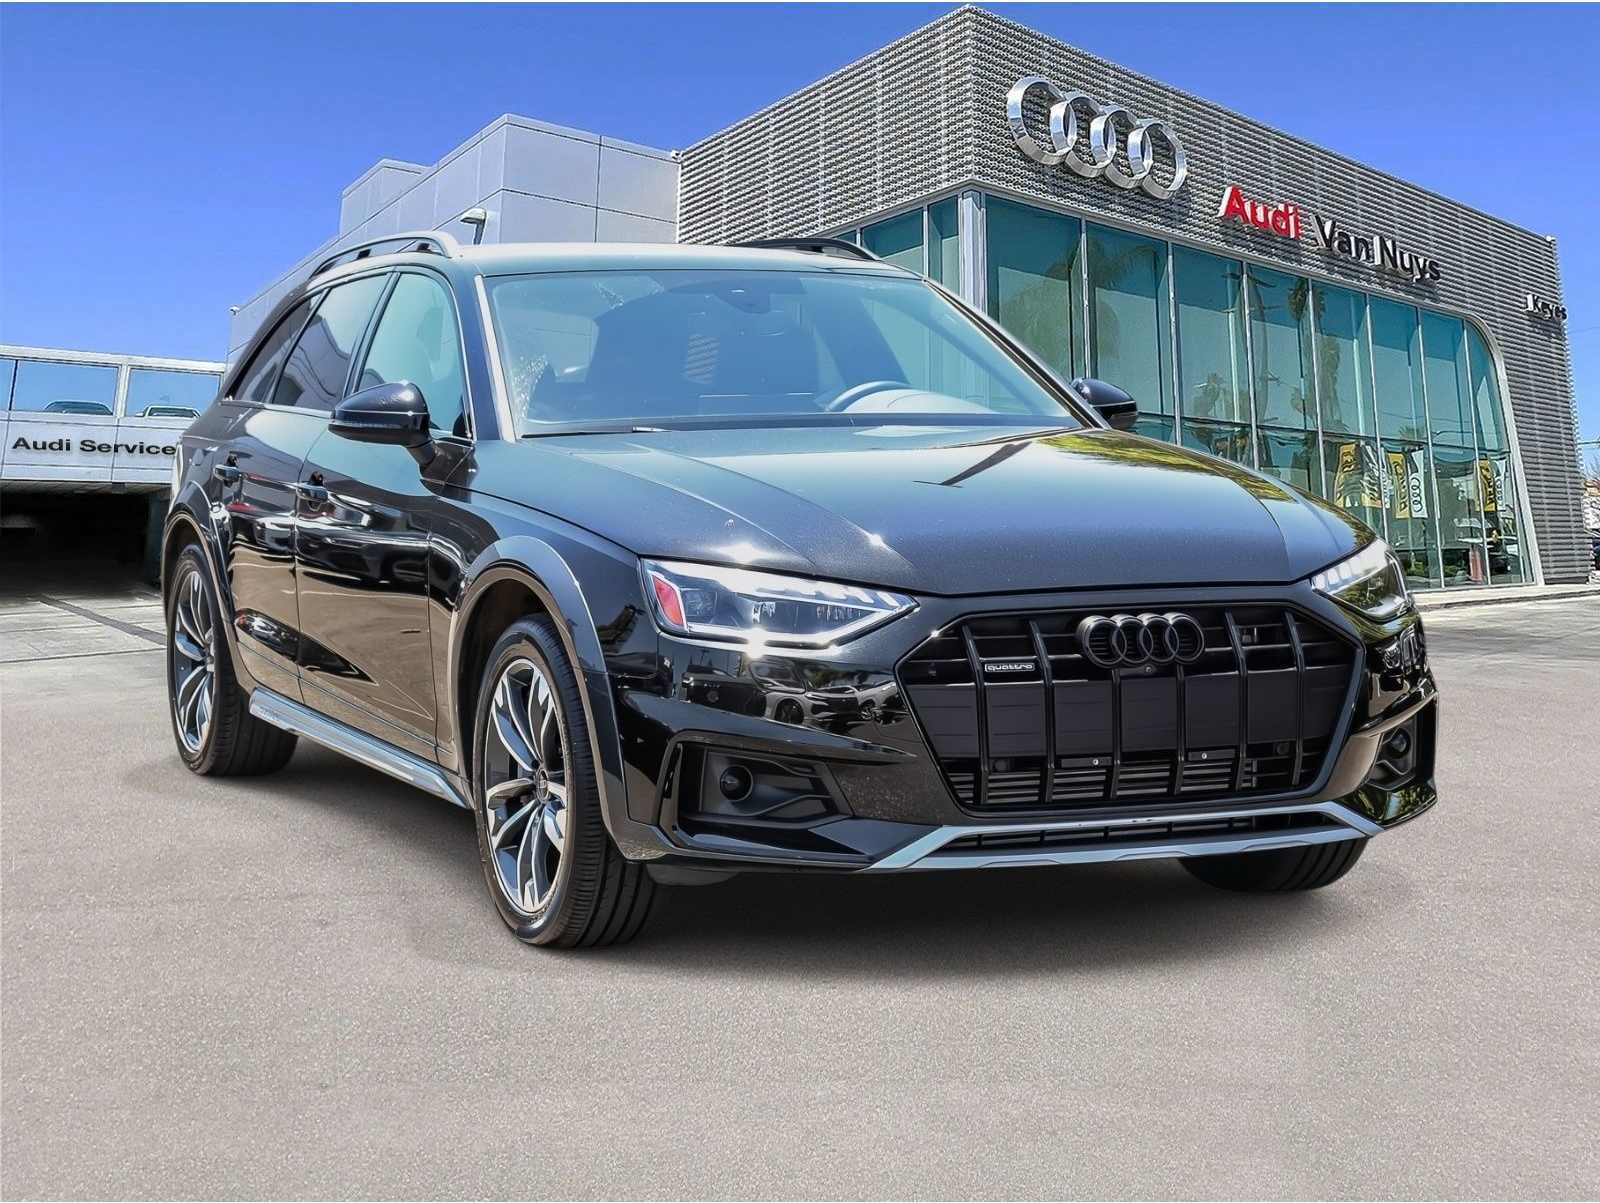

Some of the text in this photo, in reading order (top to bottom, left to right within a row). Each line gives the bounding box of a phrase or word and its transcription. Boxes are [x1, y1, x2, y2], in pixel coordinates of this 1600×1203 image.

[1217, 185, 1440, 281] Audi Van Nuys
[12, 437, 177, 455] Audi Service
[986, 663, 1034, 672] quattro
